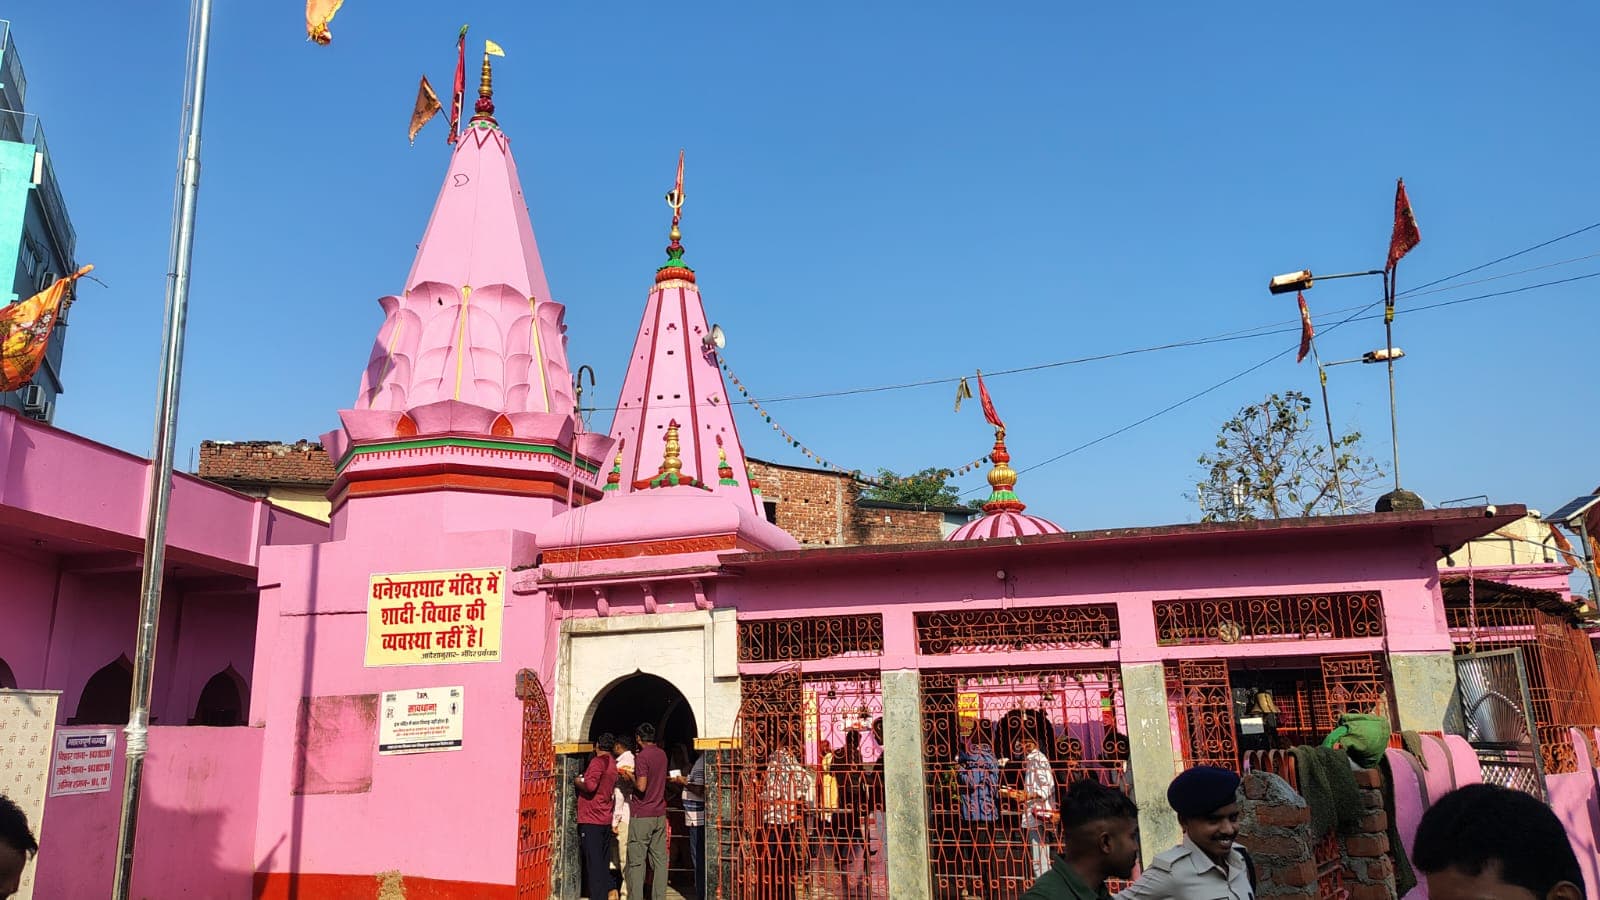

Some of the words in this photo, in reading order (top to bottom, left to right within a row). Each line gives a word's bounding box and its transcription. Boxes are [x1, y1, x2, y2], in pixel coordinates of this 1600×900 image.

[372, 578, 445, 600] धनेश्वरघाट
[448, 573, 483, 596] मंदिर
[486, 571, 501, 594] में
[381, 601, 462, 625] शादी-विवाह
[465, 598, 487, 621] की
[381, 632, 432, 650] व्यवस्था
[435, 625, 465, 648] नहीं
